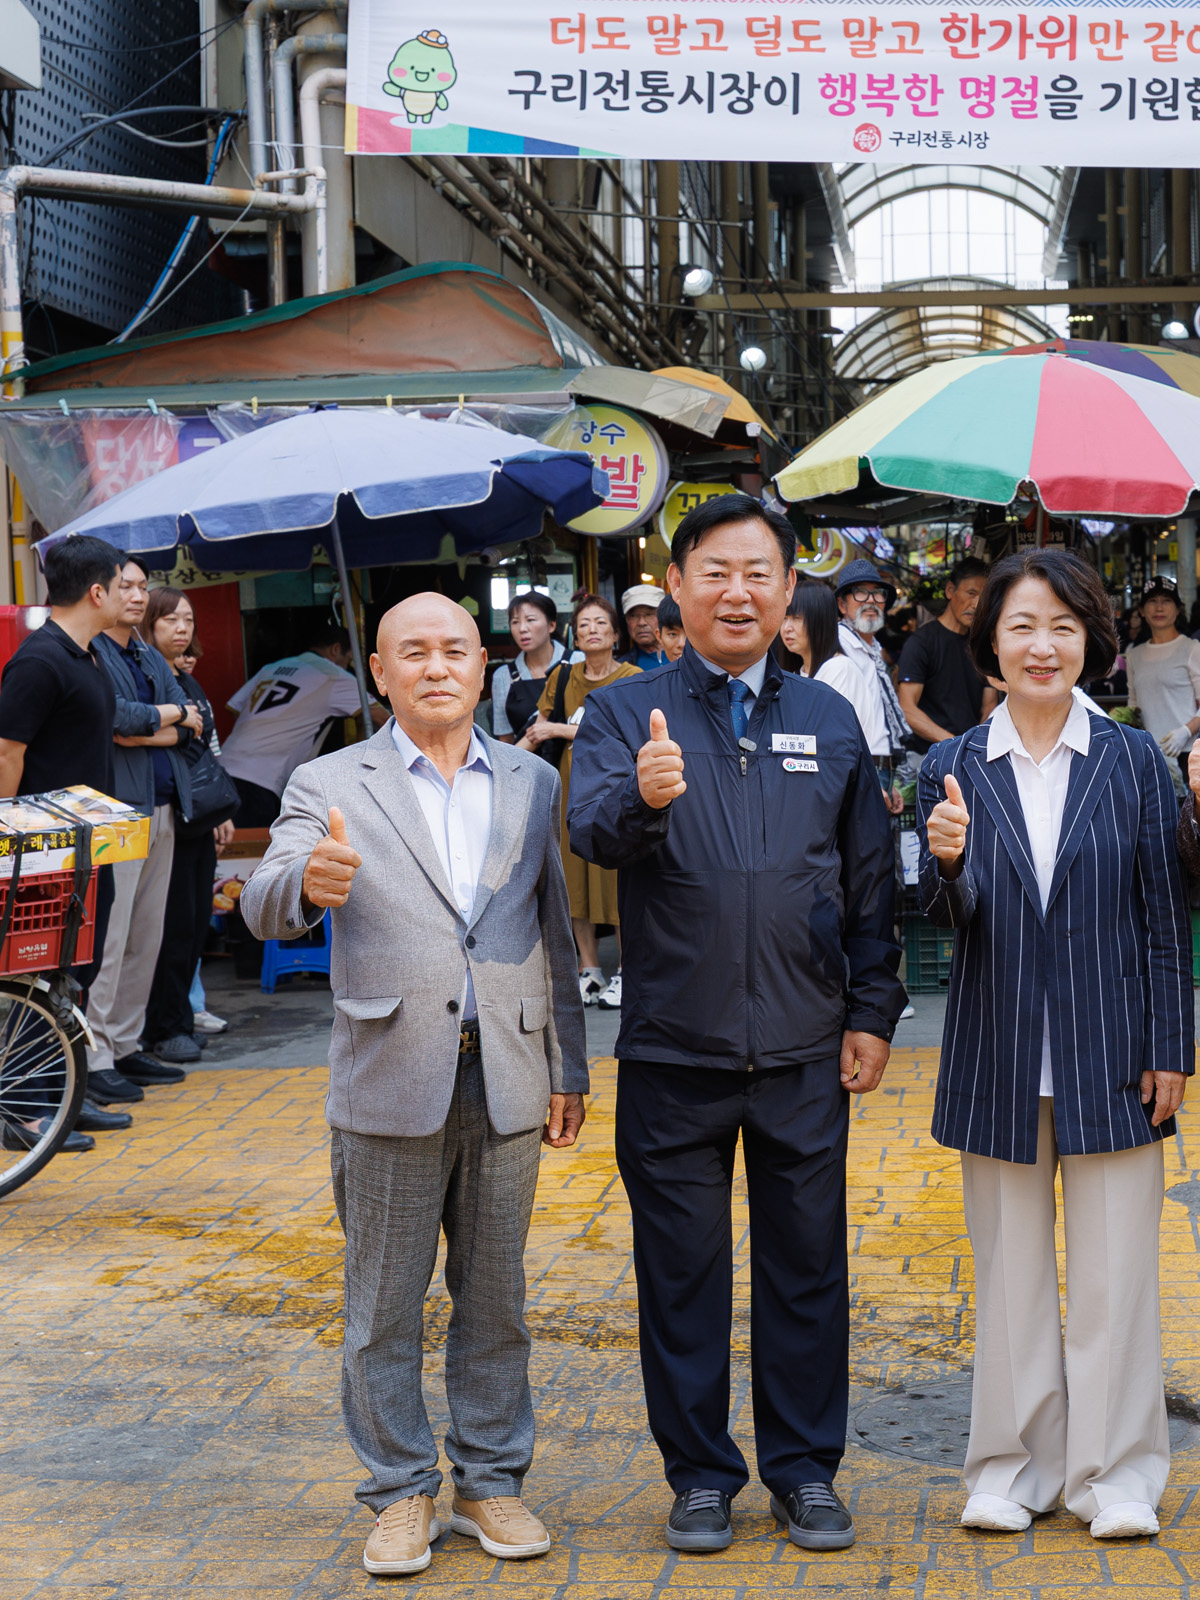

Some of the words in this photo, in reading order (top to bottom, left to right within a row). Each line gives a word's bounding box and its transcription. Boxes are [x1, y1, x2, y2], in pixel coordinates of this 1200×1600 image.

[550, 13, 630, 54] 더도
[647, 13, 729, 56] 말고
[746, 15, 826, 58] 덜도
[842, 16, 924, 59] 말고
[940, 12, 1129, 62] 한가위만
[508, 69, 801, 116] 구리전통시장이
[817, 72, 944, 118] 행복한
[959, 74, 1084, 121] 명절을
[888, 130, 990, 150] 구리전통시장
[571, 420, 626, 446] 장수
[598, 453, 648, 511] 발
[780, 741, 805, 750] 신동화
